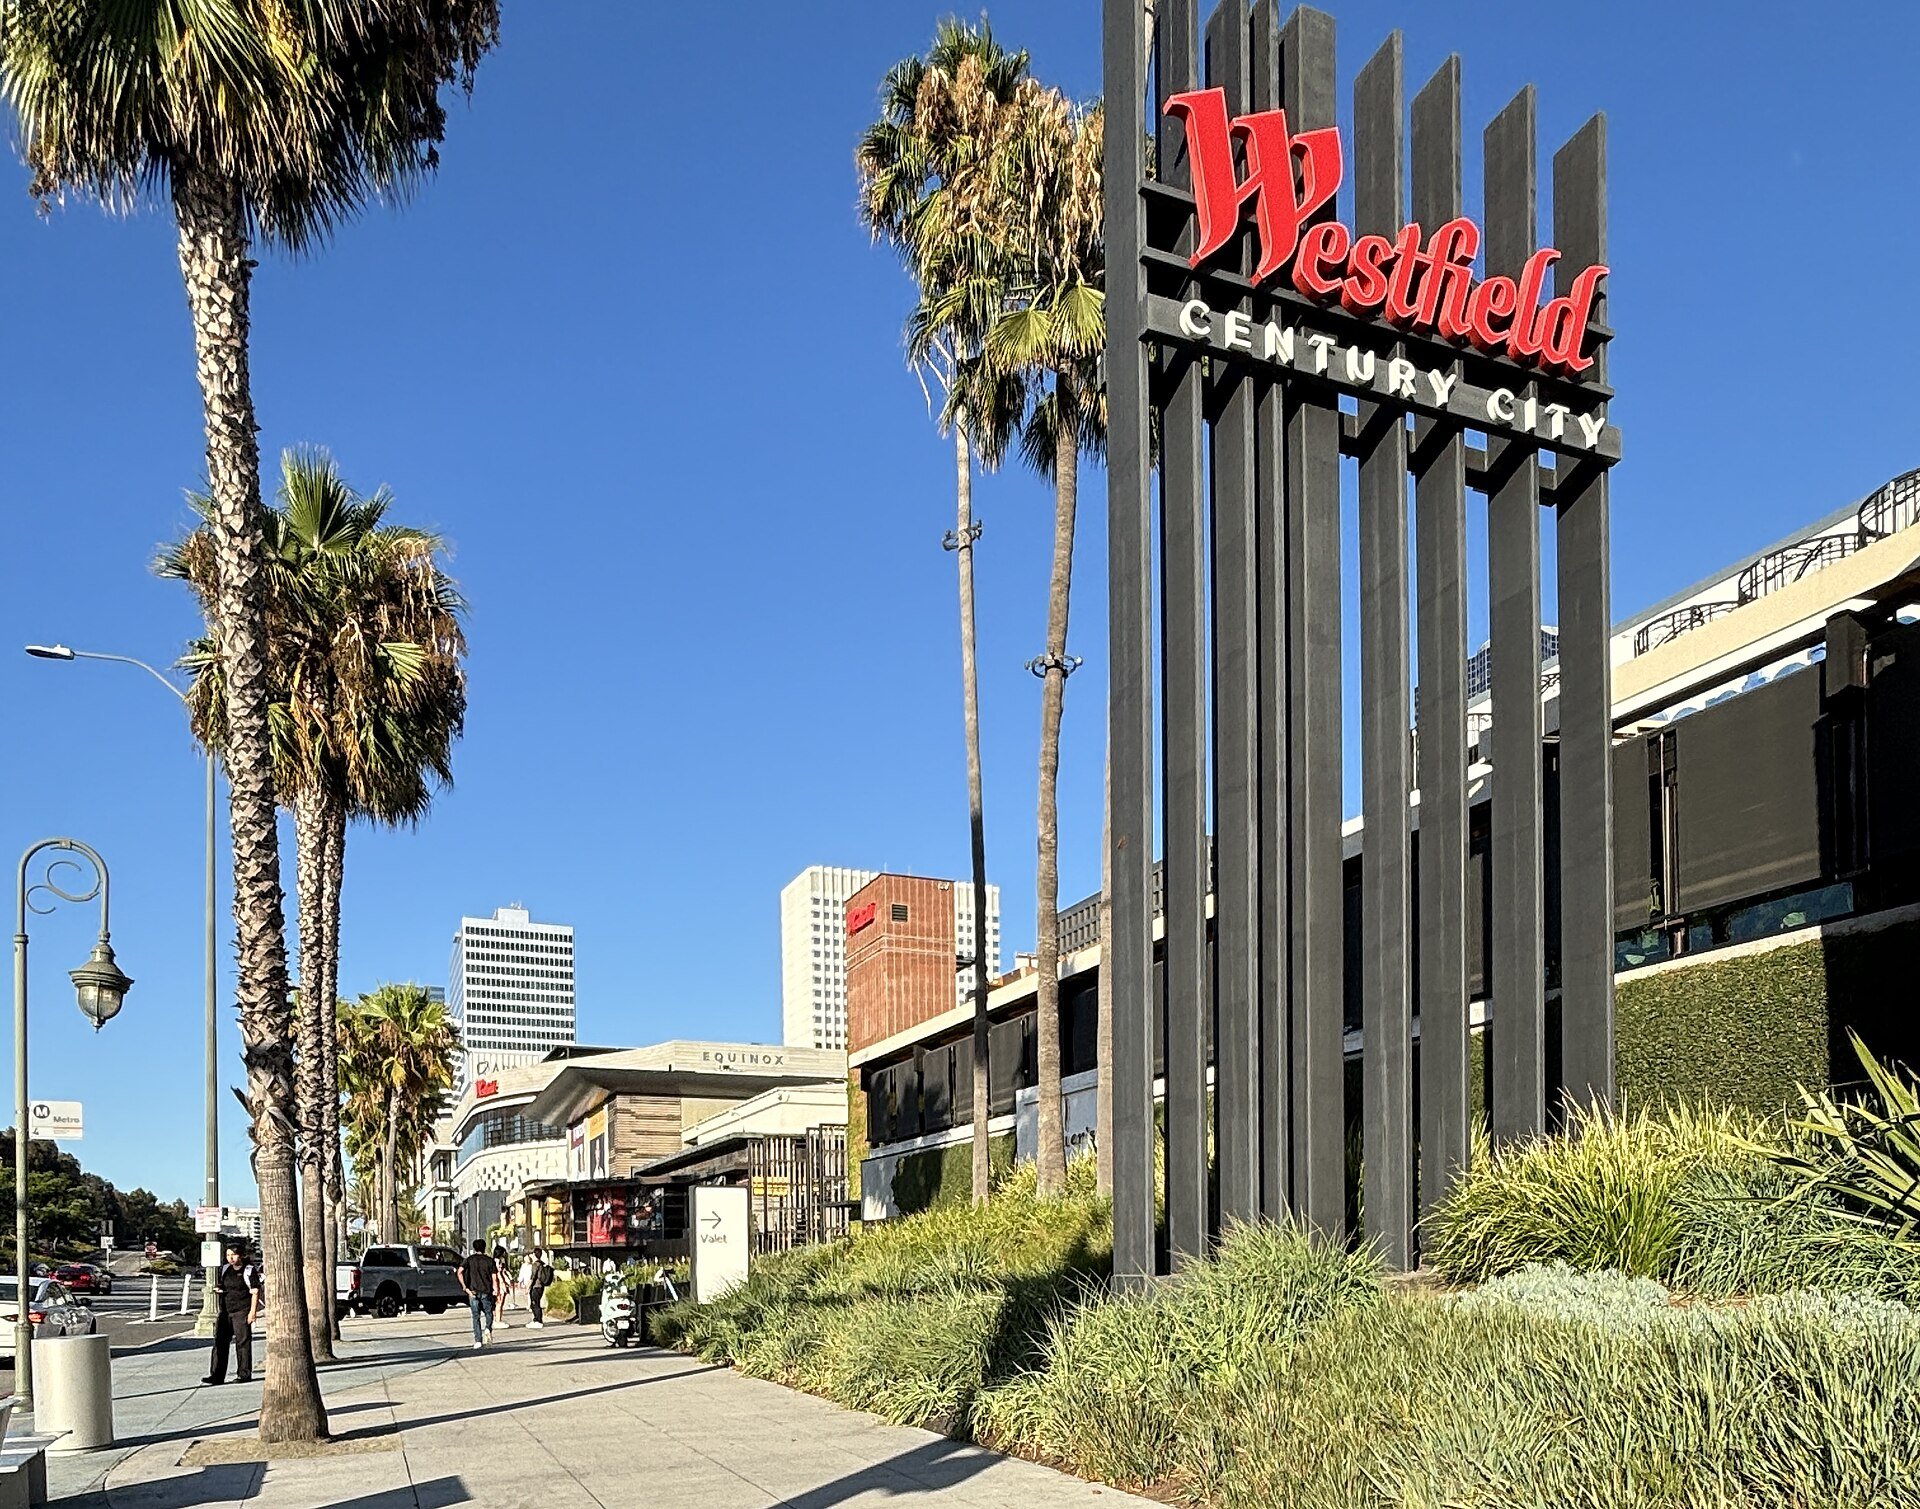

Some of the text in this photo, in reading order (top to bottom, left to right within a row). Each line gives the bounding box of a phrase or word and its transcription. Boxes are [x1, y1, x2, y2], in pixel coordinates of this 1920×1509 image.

[1162, 86, 1611, 373] Westfield
[1178, 299, 1606, 450] CENTURY CITY
[702, 1051, 785, 1065] EQUINOX
[700, 1233, 728, 1244] Valet
